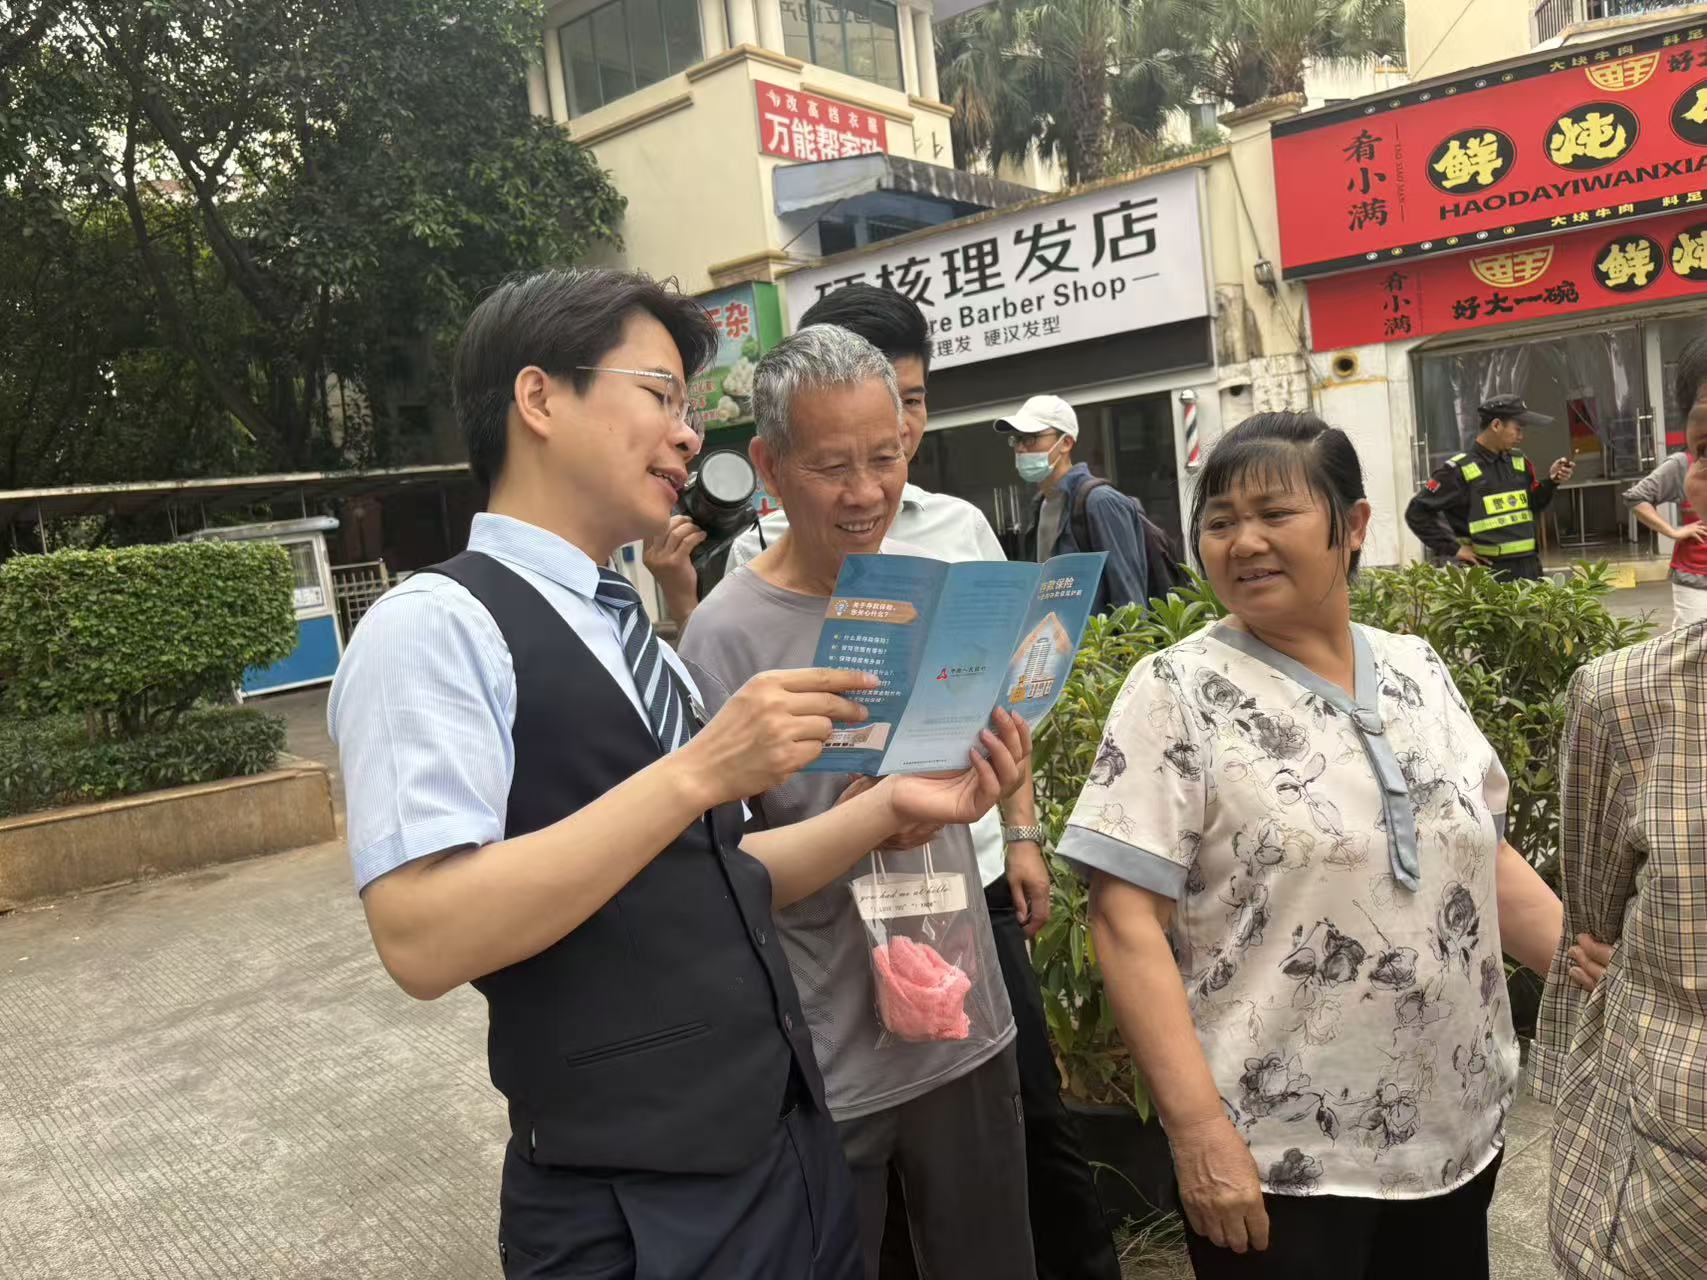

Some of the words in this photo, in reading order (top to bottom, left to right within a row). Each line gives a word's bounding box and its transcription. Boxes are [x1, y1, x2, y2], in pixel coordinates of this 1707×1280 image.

[1550, 45, 1633, 72] 大块牛肉
[1342, 128, 1388, 231] 肴小满
[1550, 203, 1634, 227] 大块牛肉
[1662, 190, 1703, 207] 料足
[814, 197, 1158, 308] 核理发店
[928, 316, 953, 337] re
[959, 294, 1046, 328] Barber
[1053, 274, 1127, 307] Shop
[1451, 280, 1580, 321] 好大一碗
[984, 315, 1061, 347] 硬汉发型
